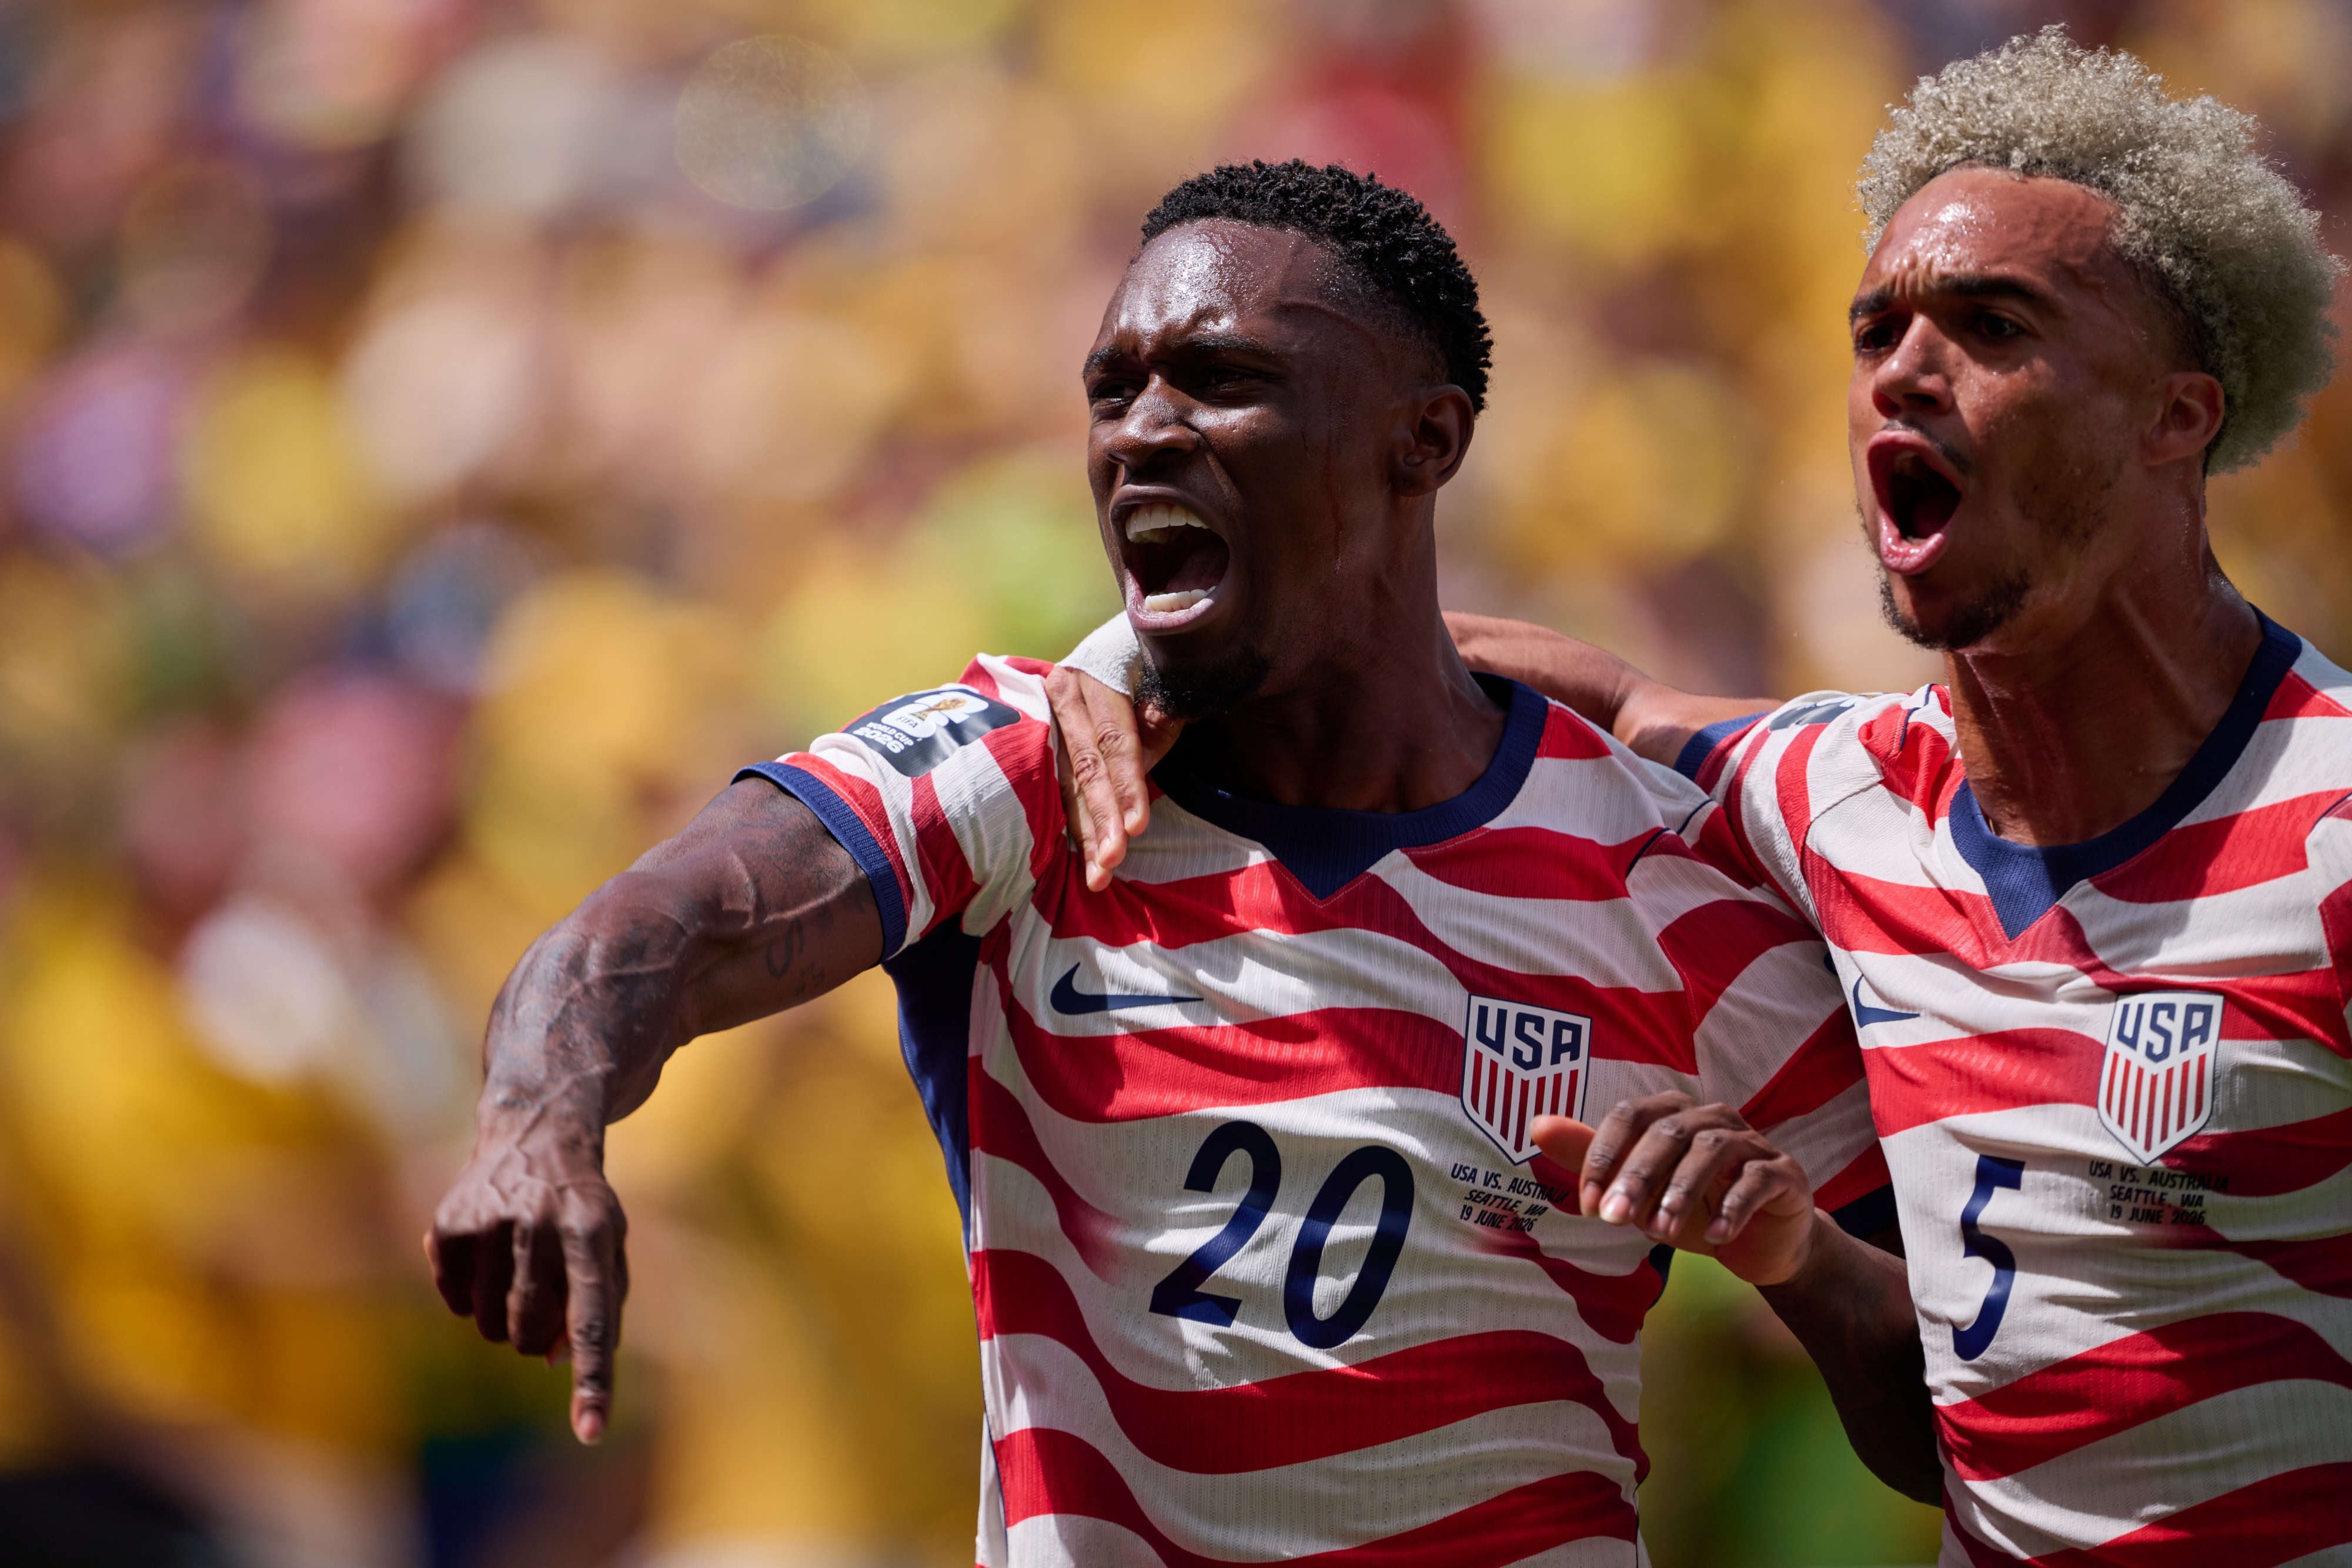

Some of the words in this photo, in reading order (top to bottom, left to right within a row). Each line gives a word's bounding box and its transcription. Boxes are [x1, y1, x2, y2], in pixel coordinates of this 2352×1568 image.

[866, 721, 897, 735] WORLD
[894, 731, 914, 746] CUP
[896, 716, 918, 728] FIFA
[853, 726, 905, 754] 2026
[1475, 1004, 1583, 1071] USA
[2117, 1002, 2214, 1063] USA
[1451, 1163, 1478, 1183] USA
[1483, 1171, 1502, 1189] VS.
[1507, 1177, 1571, 1204] AUSTRALIA
[2089, 1160, 2113, 1179] USA
[2120, 1166, 2140, 1183] VS.
[2148, 1170, 2229, 1191] AUSTRALIA
[1464, 1189, 1522, 1215] SEATTLE,
[1524, 1203, 1549, 1216] WA
[2110, 1184, 2171, 1208] SEATTLE,
[2180, 1193, 2204, 1208] WA
[1460, 1204, 1474, 1221] 19
[1474, 1209, 1508, 1229] JUNE
[1506, 1216, 1538, 1232] 2026
[2110, 1204, 2122, 1219] 19
[2129, 1208, 2164, 1224] JUNE
[2171, 1210, 2207, 1225] 2026
[1148, 1120, 1415, 1349] 20
[1952, 1154, 2026, 1361] 5
